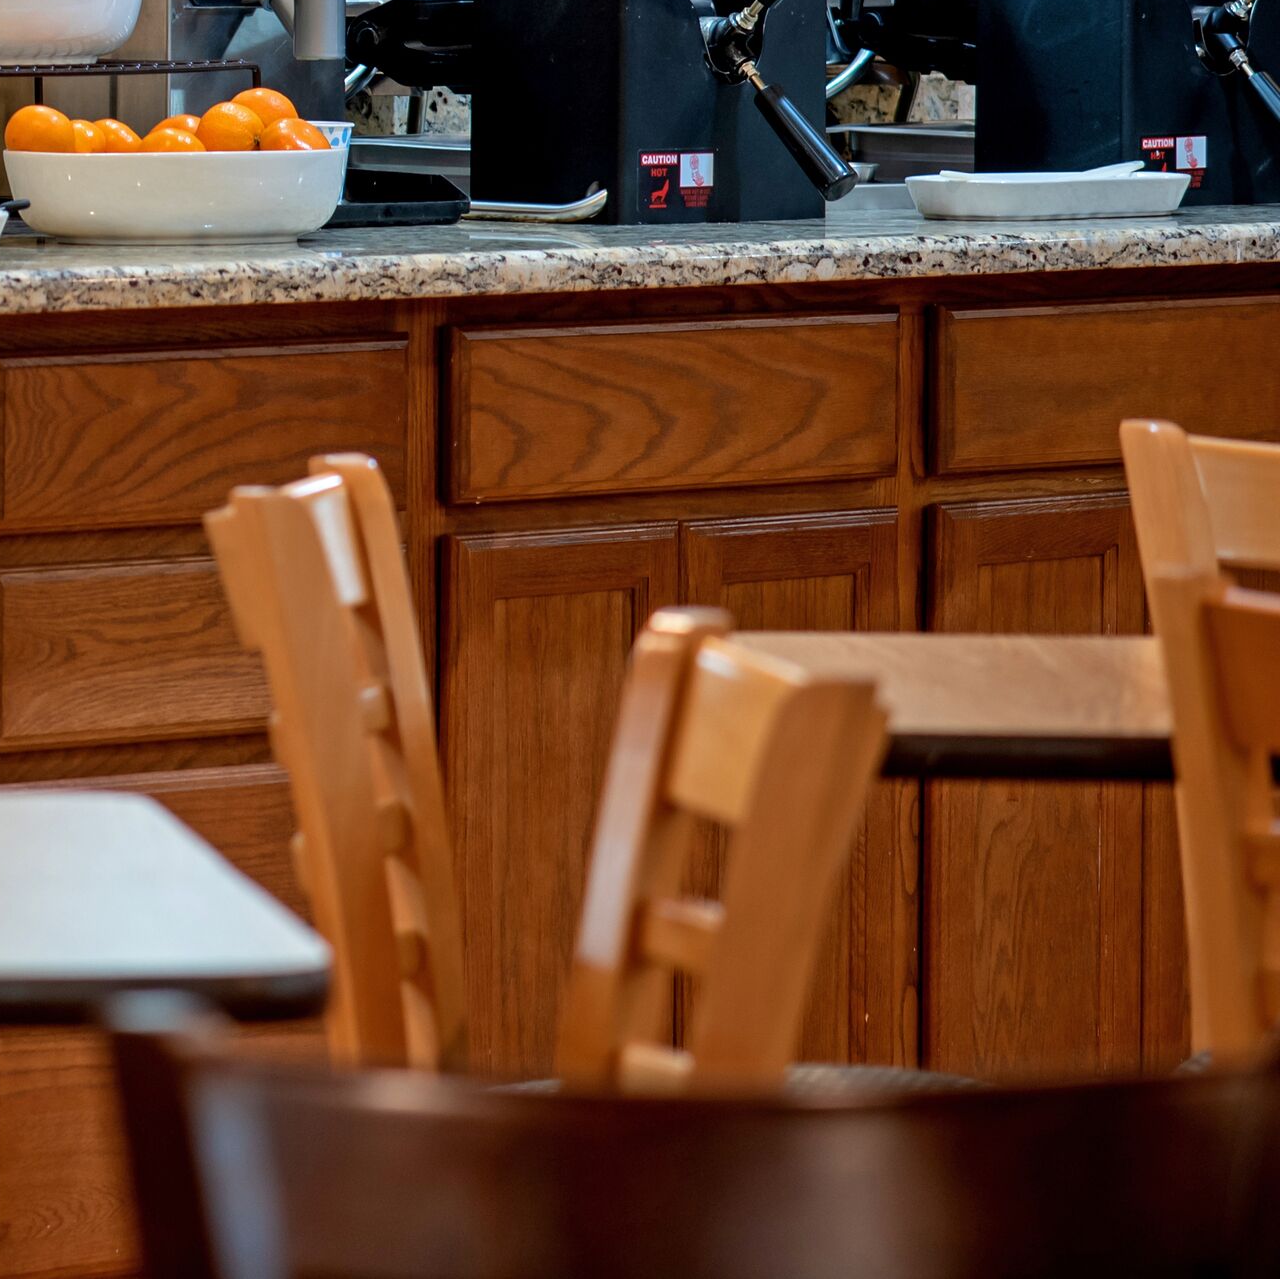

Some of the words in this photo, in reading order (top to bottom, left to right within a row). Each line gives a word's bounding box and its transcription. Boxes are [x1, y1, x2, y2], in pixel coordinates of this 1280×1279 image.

[1142, 138, 1174, 148] CAUTION
[641, 154, 678, 165] CAUTION
[651, 168, 668, 177] HOT
